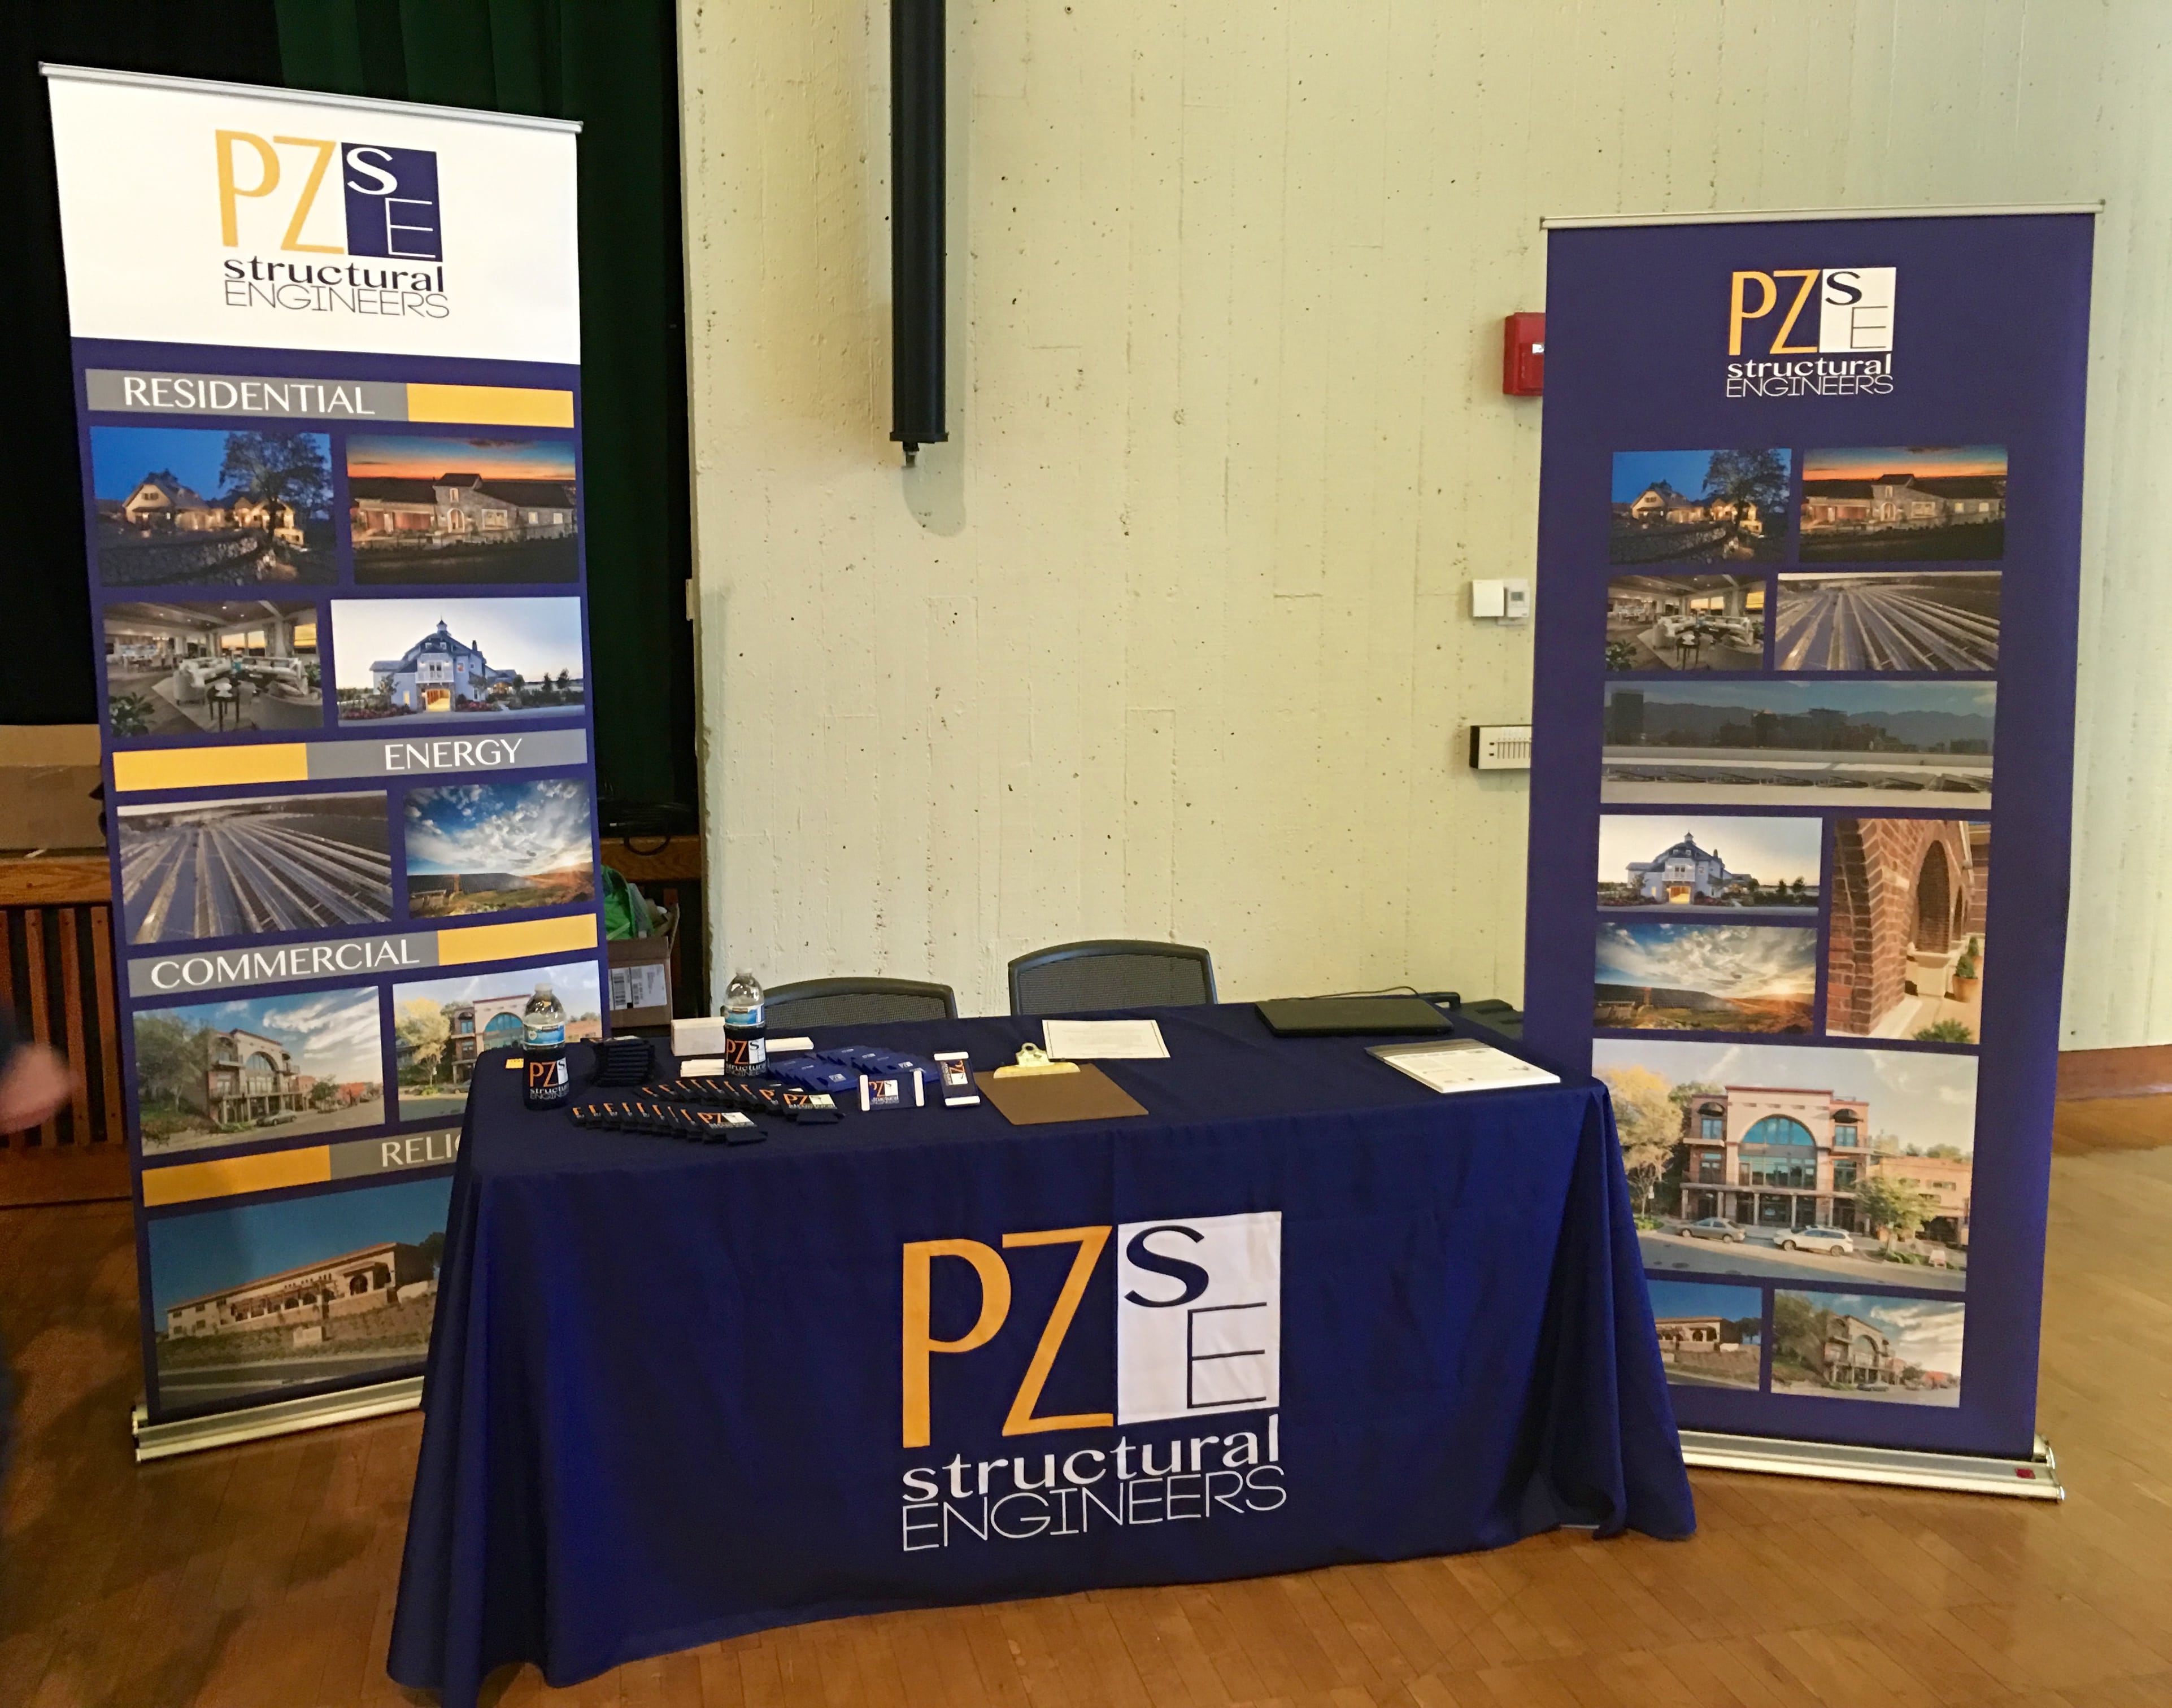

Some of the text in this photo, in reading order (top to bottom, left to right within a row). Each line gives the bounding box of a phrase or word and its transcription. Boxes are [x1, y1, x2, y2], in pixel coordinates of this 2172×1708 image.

[223, 255, 445, 293] structural
[225, 280, 450, 319] ENGINEERS
[1727, 353, 1892, 378] structural
[123, 375, 376, 416] RESIDENTIAL
[1726, 374, 1894, 398] ENGINEERS
[385, 738, 522, 770] ENERGY
[151, 939, 420, 989] COMMERCIAL
[902, 1414, 1278, 1502] structural
[903, 1465, 1287, 1551] ENGINEERS
